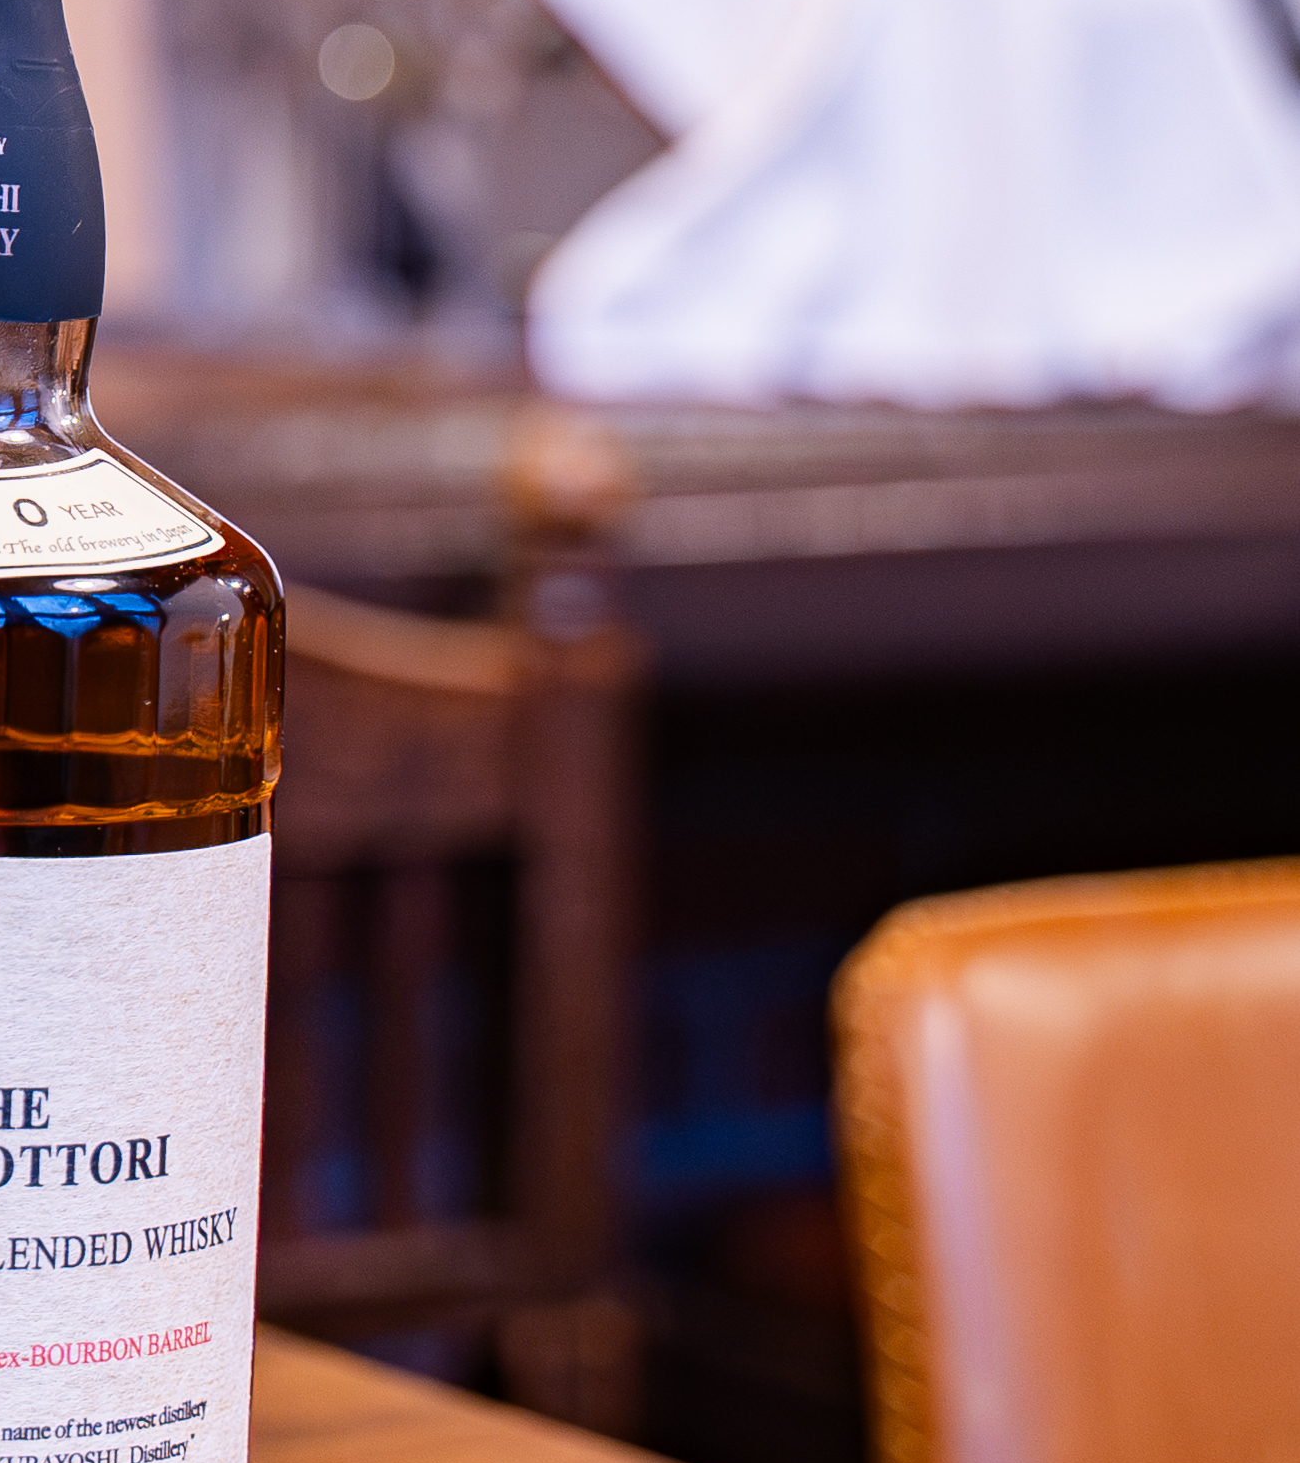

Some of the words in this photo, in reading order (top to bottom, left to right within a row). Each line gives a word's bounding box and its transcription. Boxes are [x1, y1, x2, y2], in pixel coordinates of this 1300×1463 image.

[58, 500, 124, 521] YEAR
[49, 536, 73, 553] old
[78, 534, 144, 551] brewery
[141, 530, 157, 543] in
[157, 523, 193, 544] Japan
[143, 1207, 237, 1260] WHISKY
[147, 1321, 212, 1357] BARREL
[1, 1427, 50, 1441] name
[55, 1418, 75, 1439] of
[76, 1417, 102, 1438] the
[105, 1412, 157, 1435] newest
[158, 1399, 207, 1426] distillery
